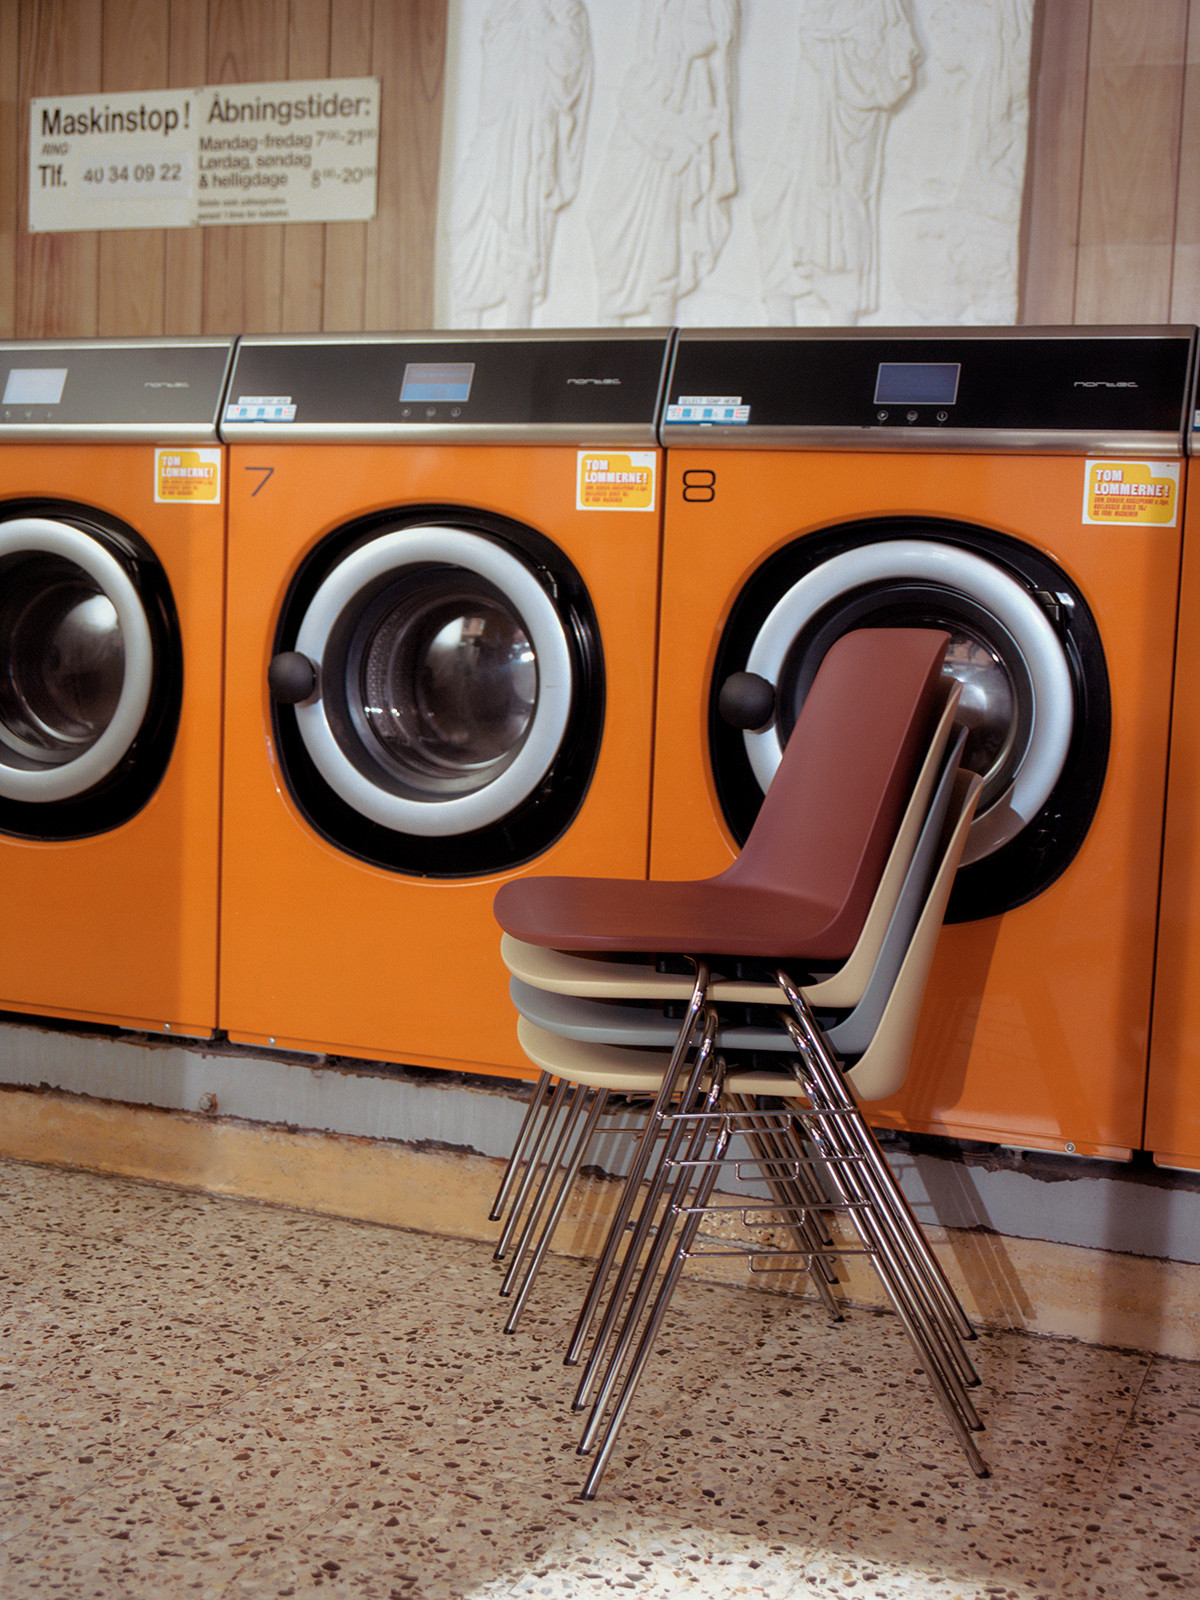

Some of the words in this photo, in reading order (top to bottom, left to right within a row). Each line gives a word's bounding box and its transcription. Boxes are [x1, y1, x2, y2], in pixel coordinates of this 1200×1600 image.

[207, 92, 371, 126] Åbningstider:
[255, 152, 312, 170] søndag
[38, 164, 67, 188] Tlf.
[83, 167, 104, 183] 40
[108, 165, 129, 183] 34
[133, 164, 155, 182] 09
[160, 163, 182, 181] 22
[212, 172, 288, 191] helligdage
[161, 455, 181, 467] TOM
[585, 459, 609, 471] TOM
[244, 466, 274, 497] 7
[1095, 469, 1123, 482] TOM
[683, 470, 716, 502] 8
[1094, 482, 1170, 498] LOMMERNE!
